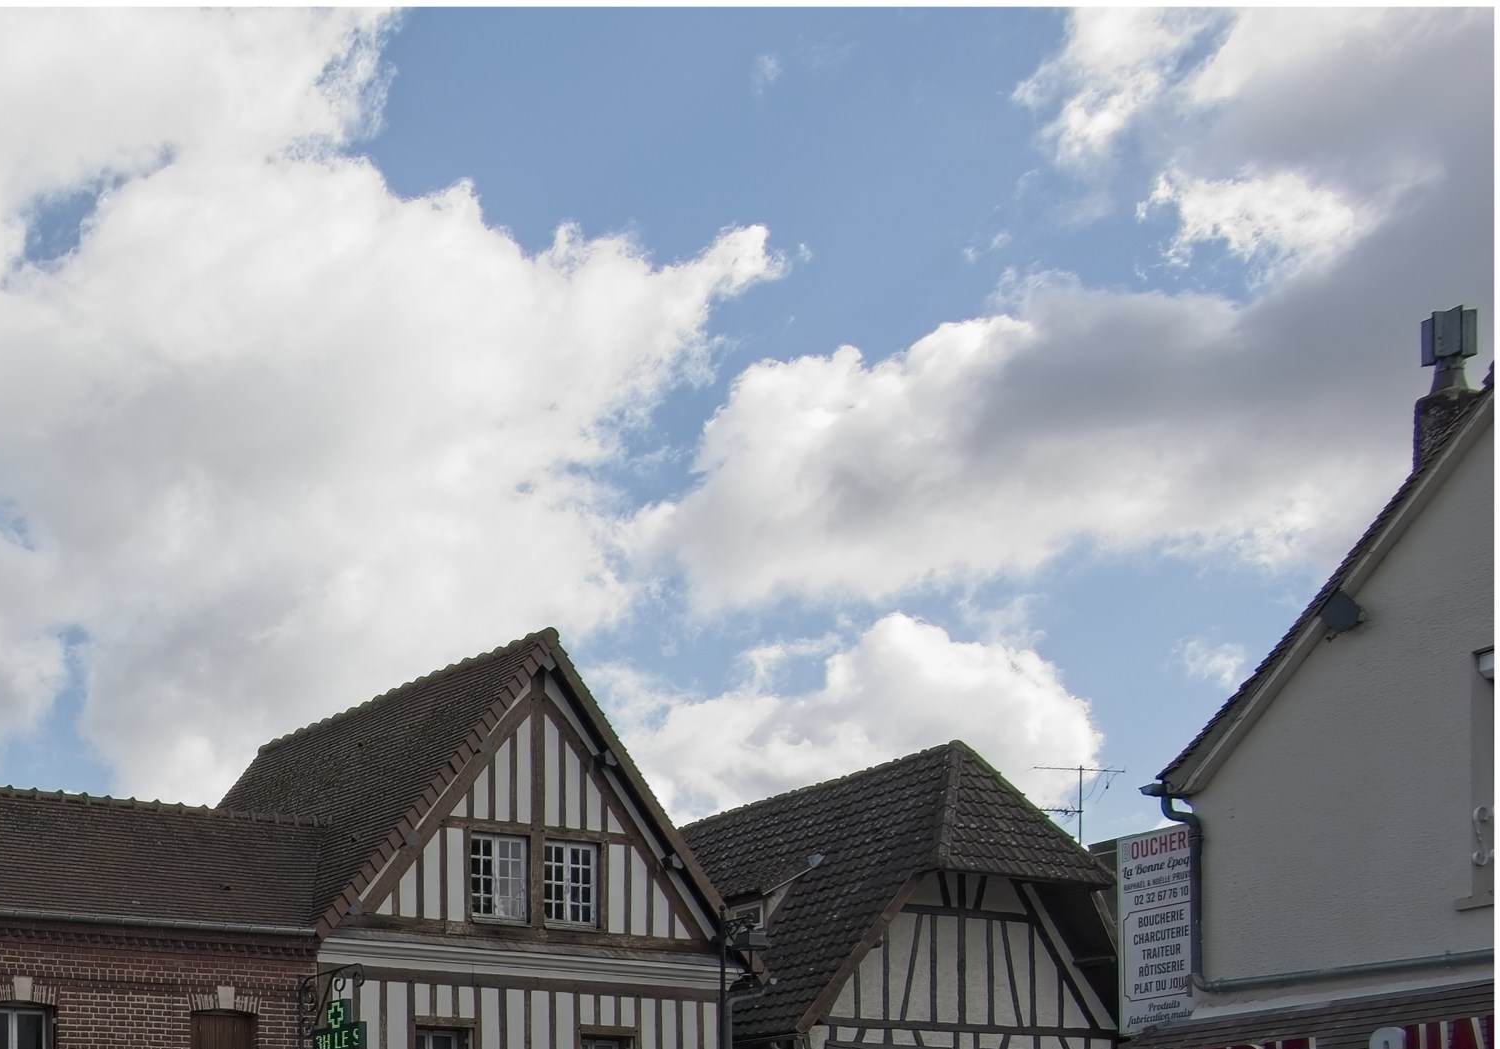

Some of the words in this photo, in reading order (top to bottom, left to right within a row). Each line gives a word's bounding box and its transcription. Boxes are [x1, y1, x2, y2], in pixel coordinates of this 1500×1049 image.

[1122, 867, 1133, 880] La
[1135, 861, 1166, 875] Bonne
[1134, 895, 1144, 906] 02
[1145, 892, 1155, 904] 32
[1157, 888, 1167, 902] 67
[1168, 887, 1178, 899] 76
[1180, 885, 1189, 897] 10
[1138, 908, 1184, 928] BOUCHERIE
[1133, 925, 1190, 946] CHARCUTERIE
[1142, 943, 1181, 960] TRAITEUR
[1138, 959, 1185, 978] RÔTISSERIE
[1134, 981, 1153, 995] PLAT
[1155, 979, 1167, 992] DU
[1148, 1000, 1181, 1012] Produits
[1127, 1010, 1170, 1028] fabrication
